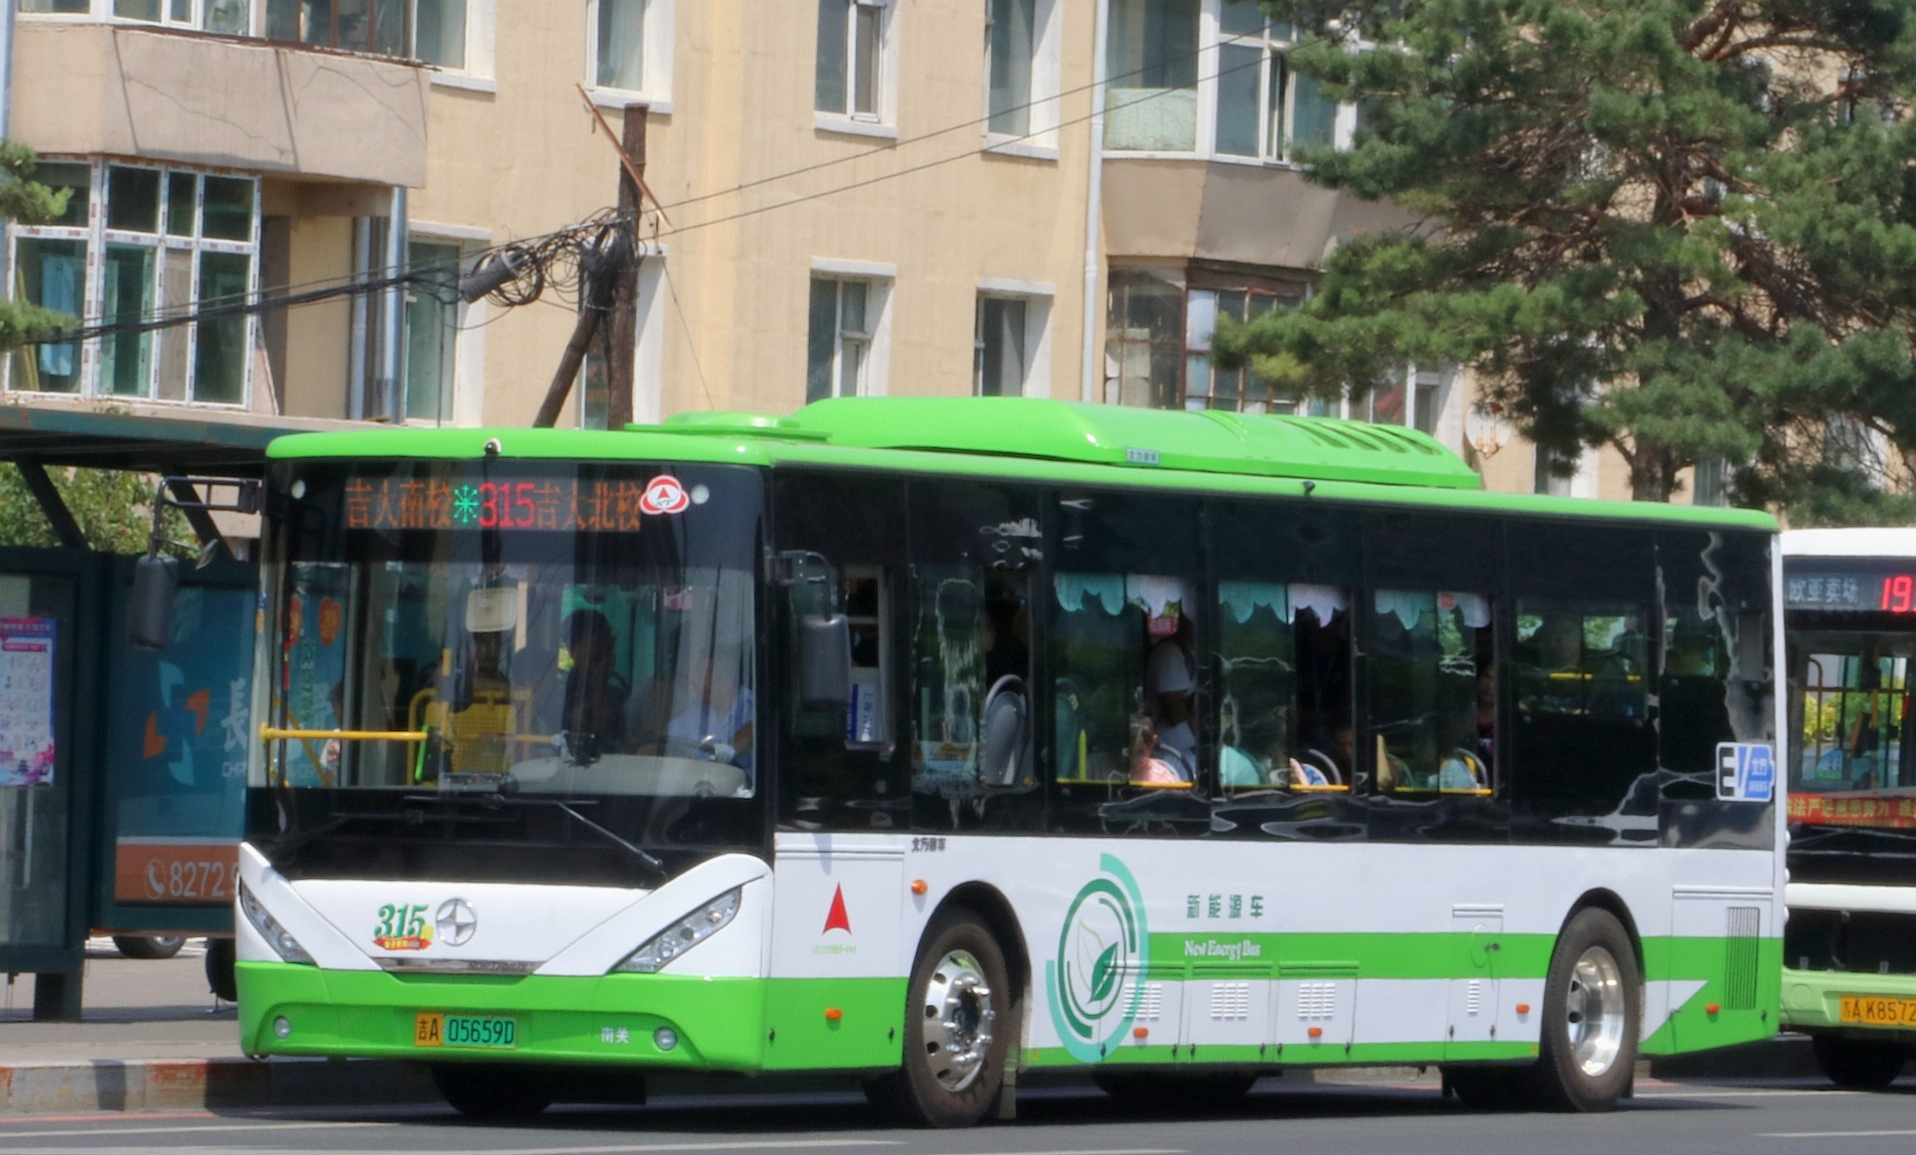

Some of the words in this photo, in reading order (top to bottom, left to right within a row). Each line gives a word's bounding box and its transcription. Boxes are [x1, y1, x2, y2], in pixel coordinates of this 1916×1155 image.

[478, 482, 536, 528] 315
[1881, 575, 1916, 612] 19
[374, 903, 429, 938] 315
[1184, 940, 1206, 957] New
[1207, 939, 1241, 961] Energy
[1242, 940, 1261, 957] Bus
